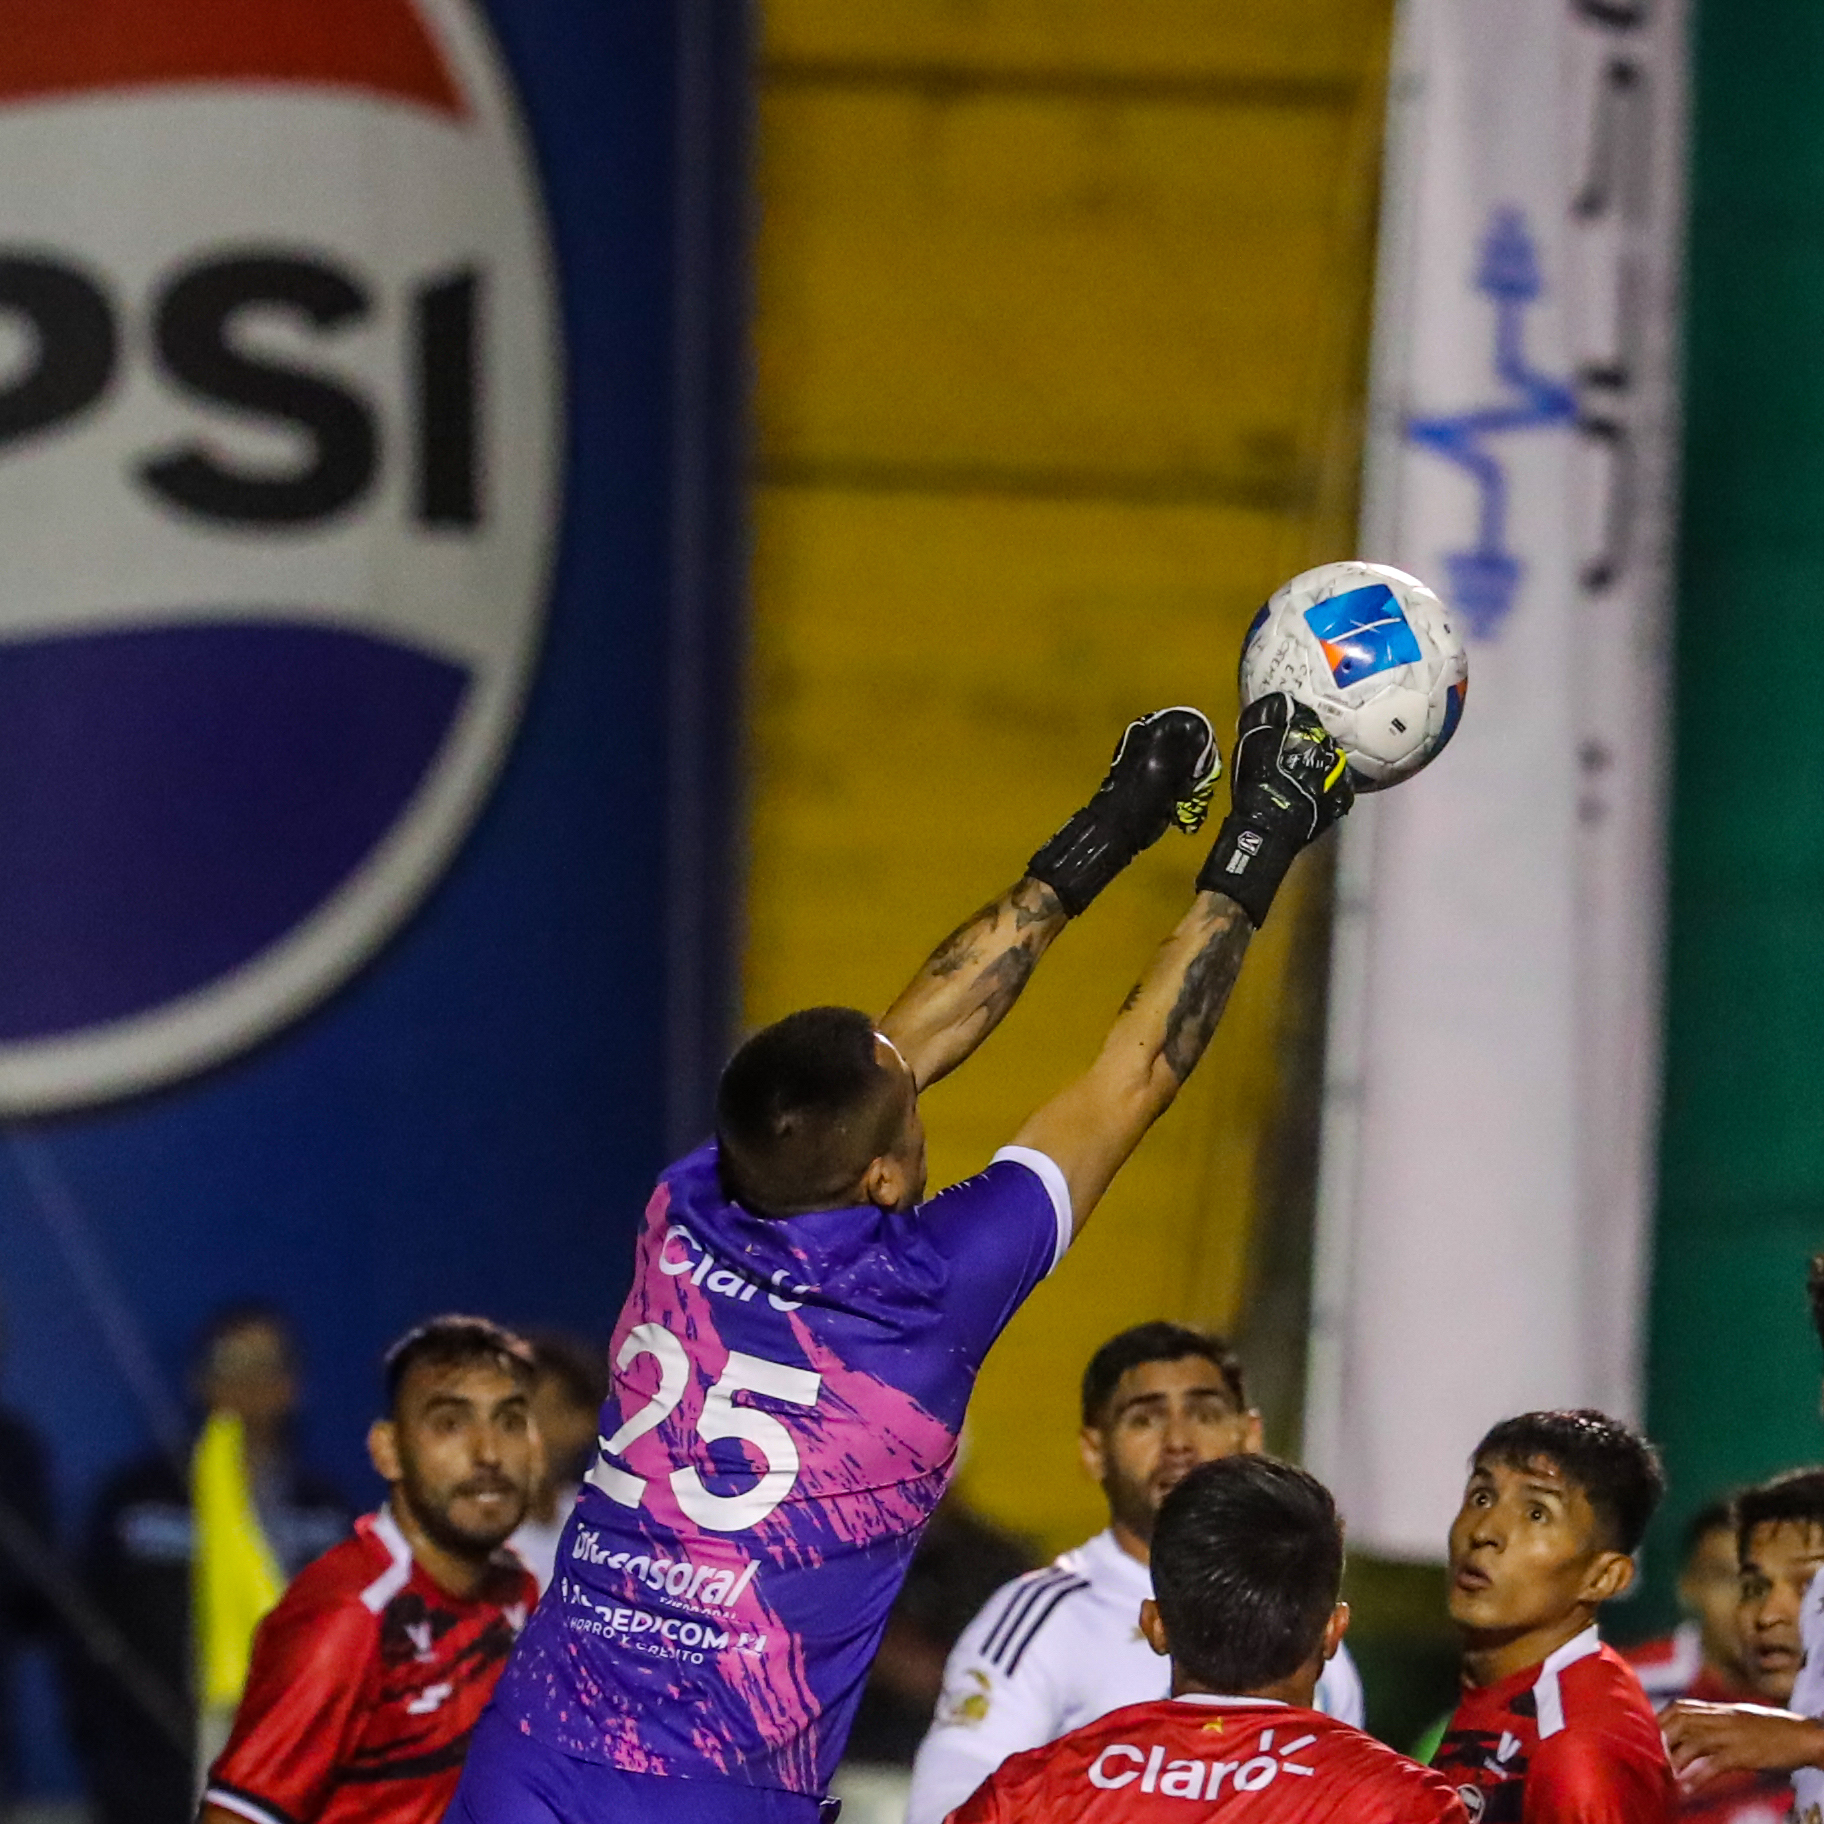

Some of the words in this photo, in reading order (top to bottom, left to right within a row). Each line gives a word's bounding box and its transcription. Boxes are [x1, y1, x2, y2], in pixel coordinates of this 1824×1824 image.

[583, 1323, 821, 1531] 25
[567, 1616, 616, 1639] HORRO
[1087, 1742, 1277, 1800] Claro
